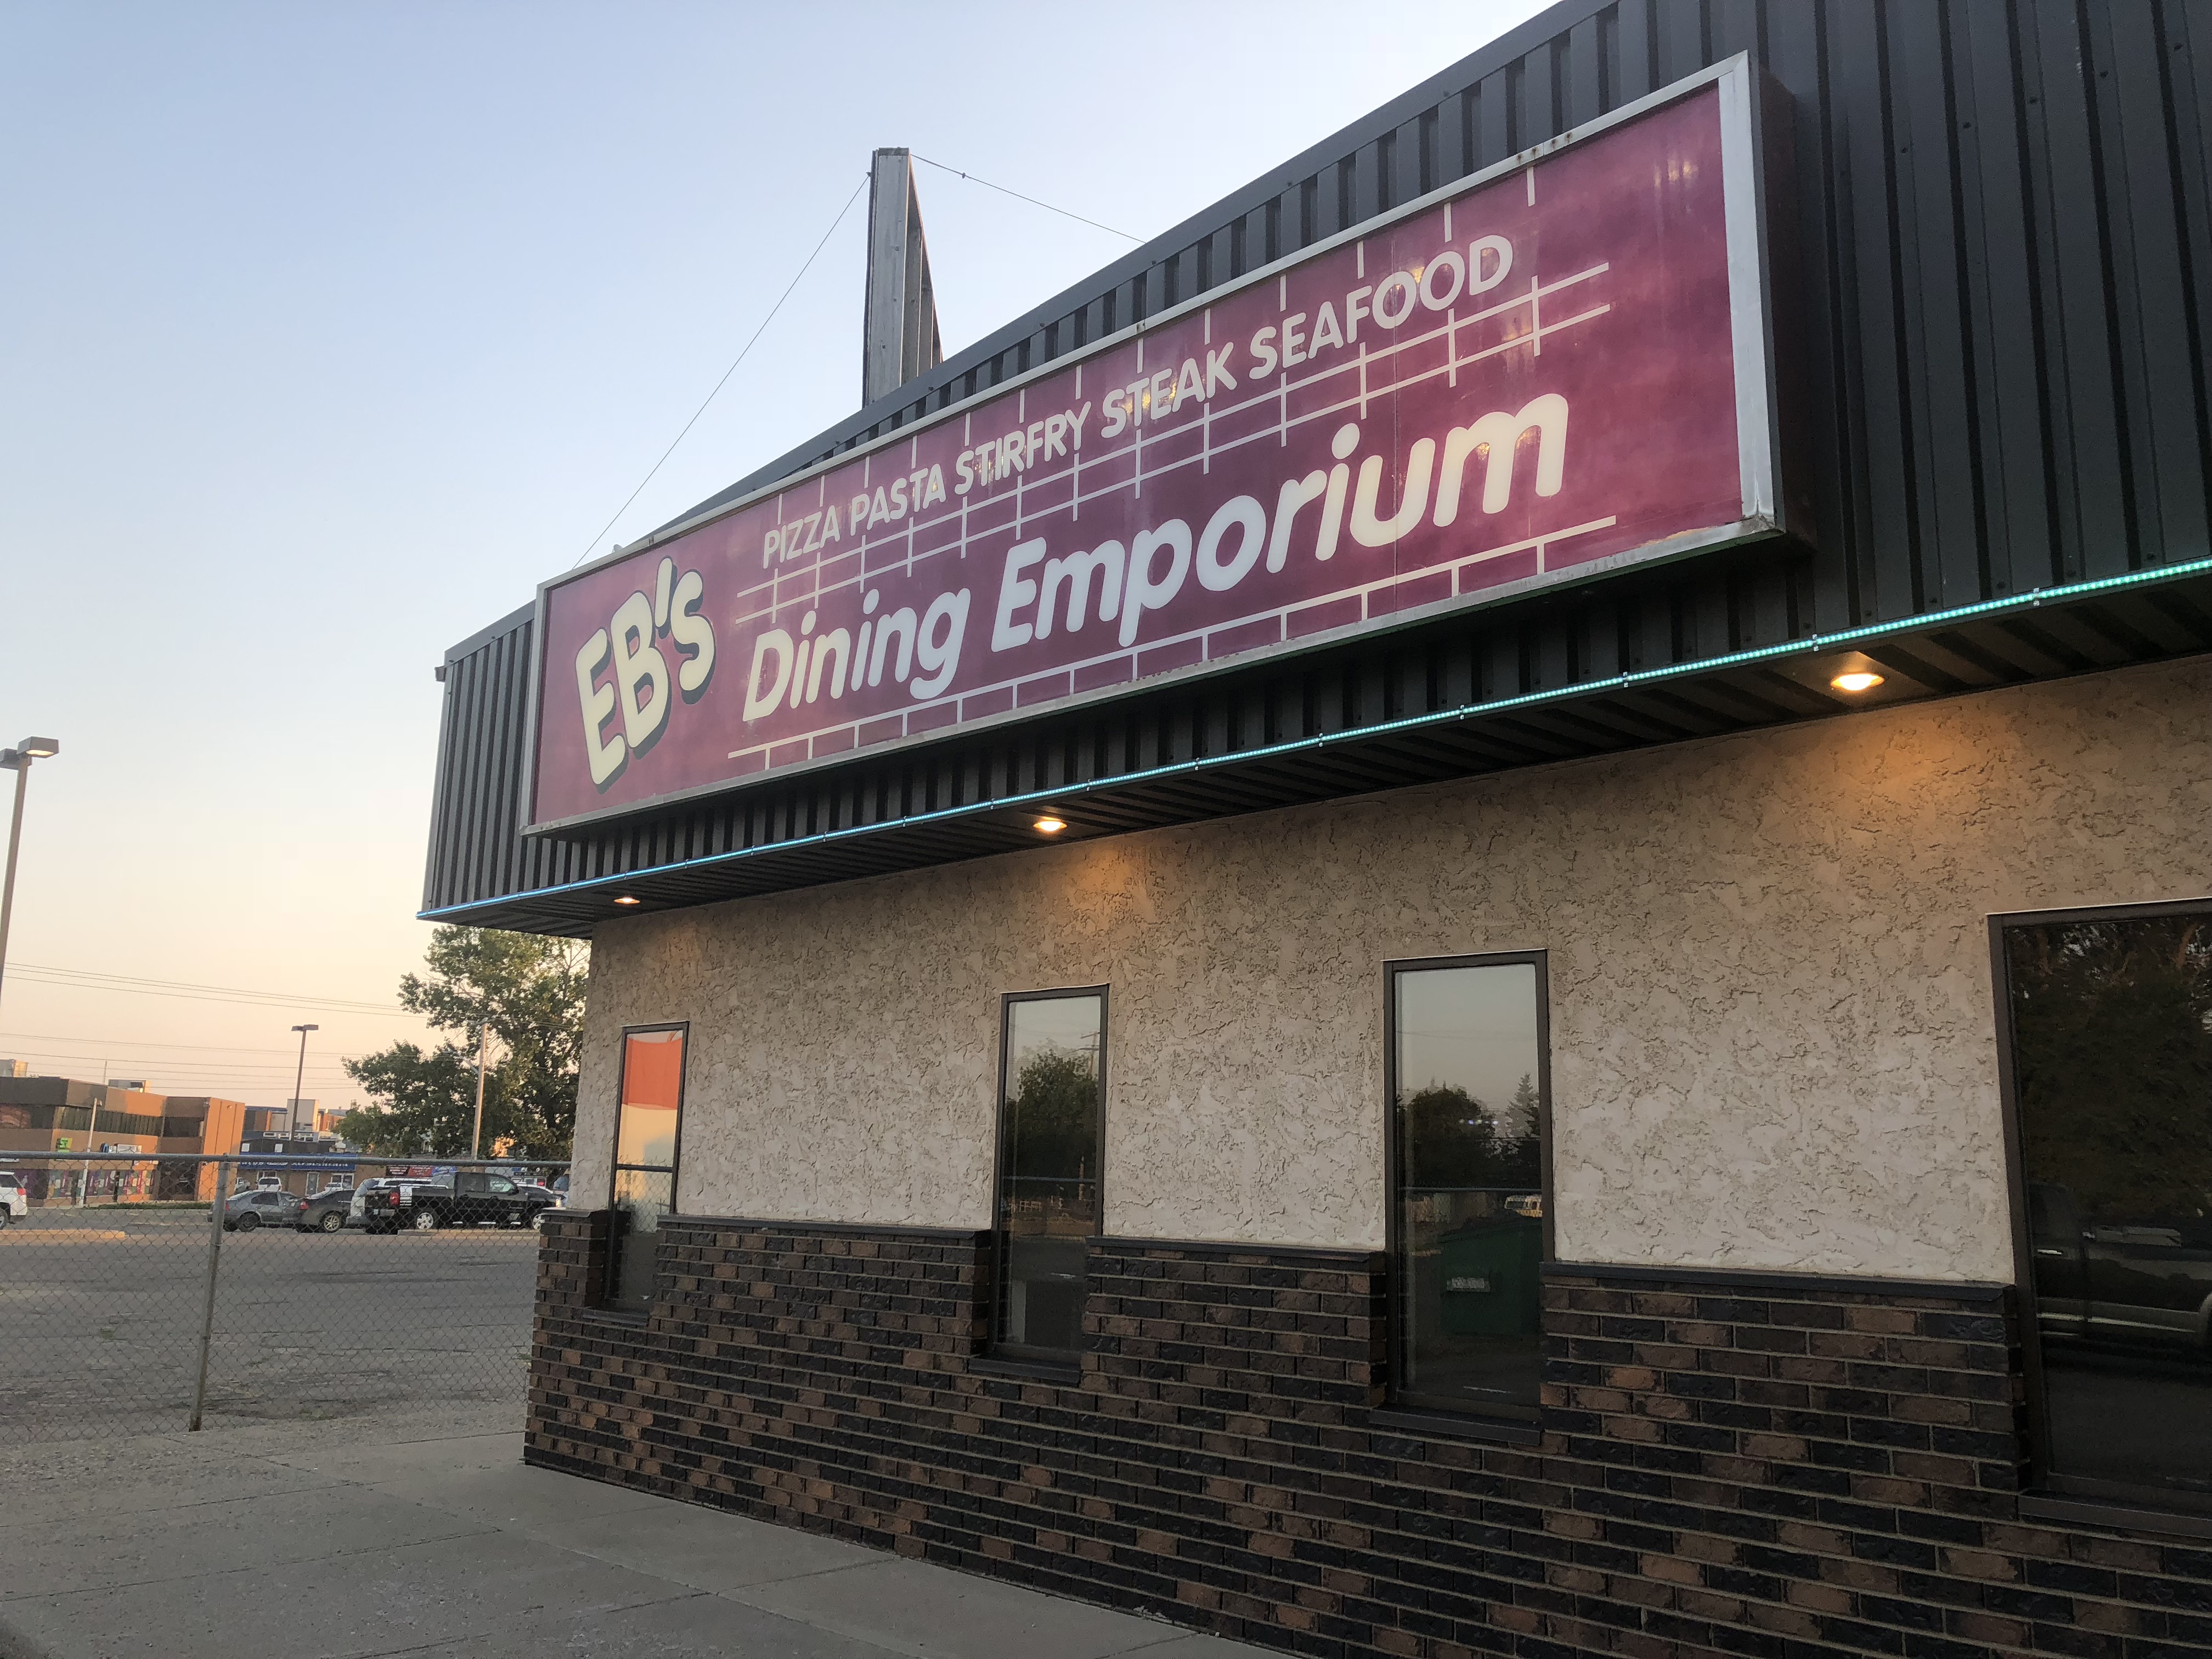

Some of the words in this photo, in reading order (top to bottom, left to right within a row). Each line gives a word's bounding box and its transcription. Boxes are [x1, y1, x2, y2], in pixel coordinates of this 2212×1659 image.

[742, 588, 971, 722] Dining
[991, 393, 1569, 652] Emporium
[763, 505, 840, 569] PIZZA
[850, 464, 946, 536] PASTA
[955, 401, 1091, 495] STIRFRY
[1101, 342, 1238, 438] STEAK
[1249, 234, 1513, 380] SEAFOOD
